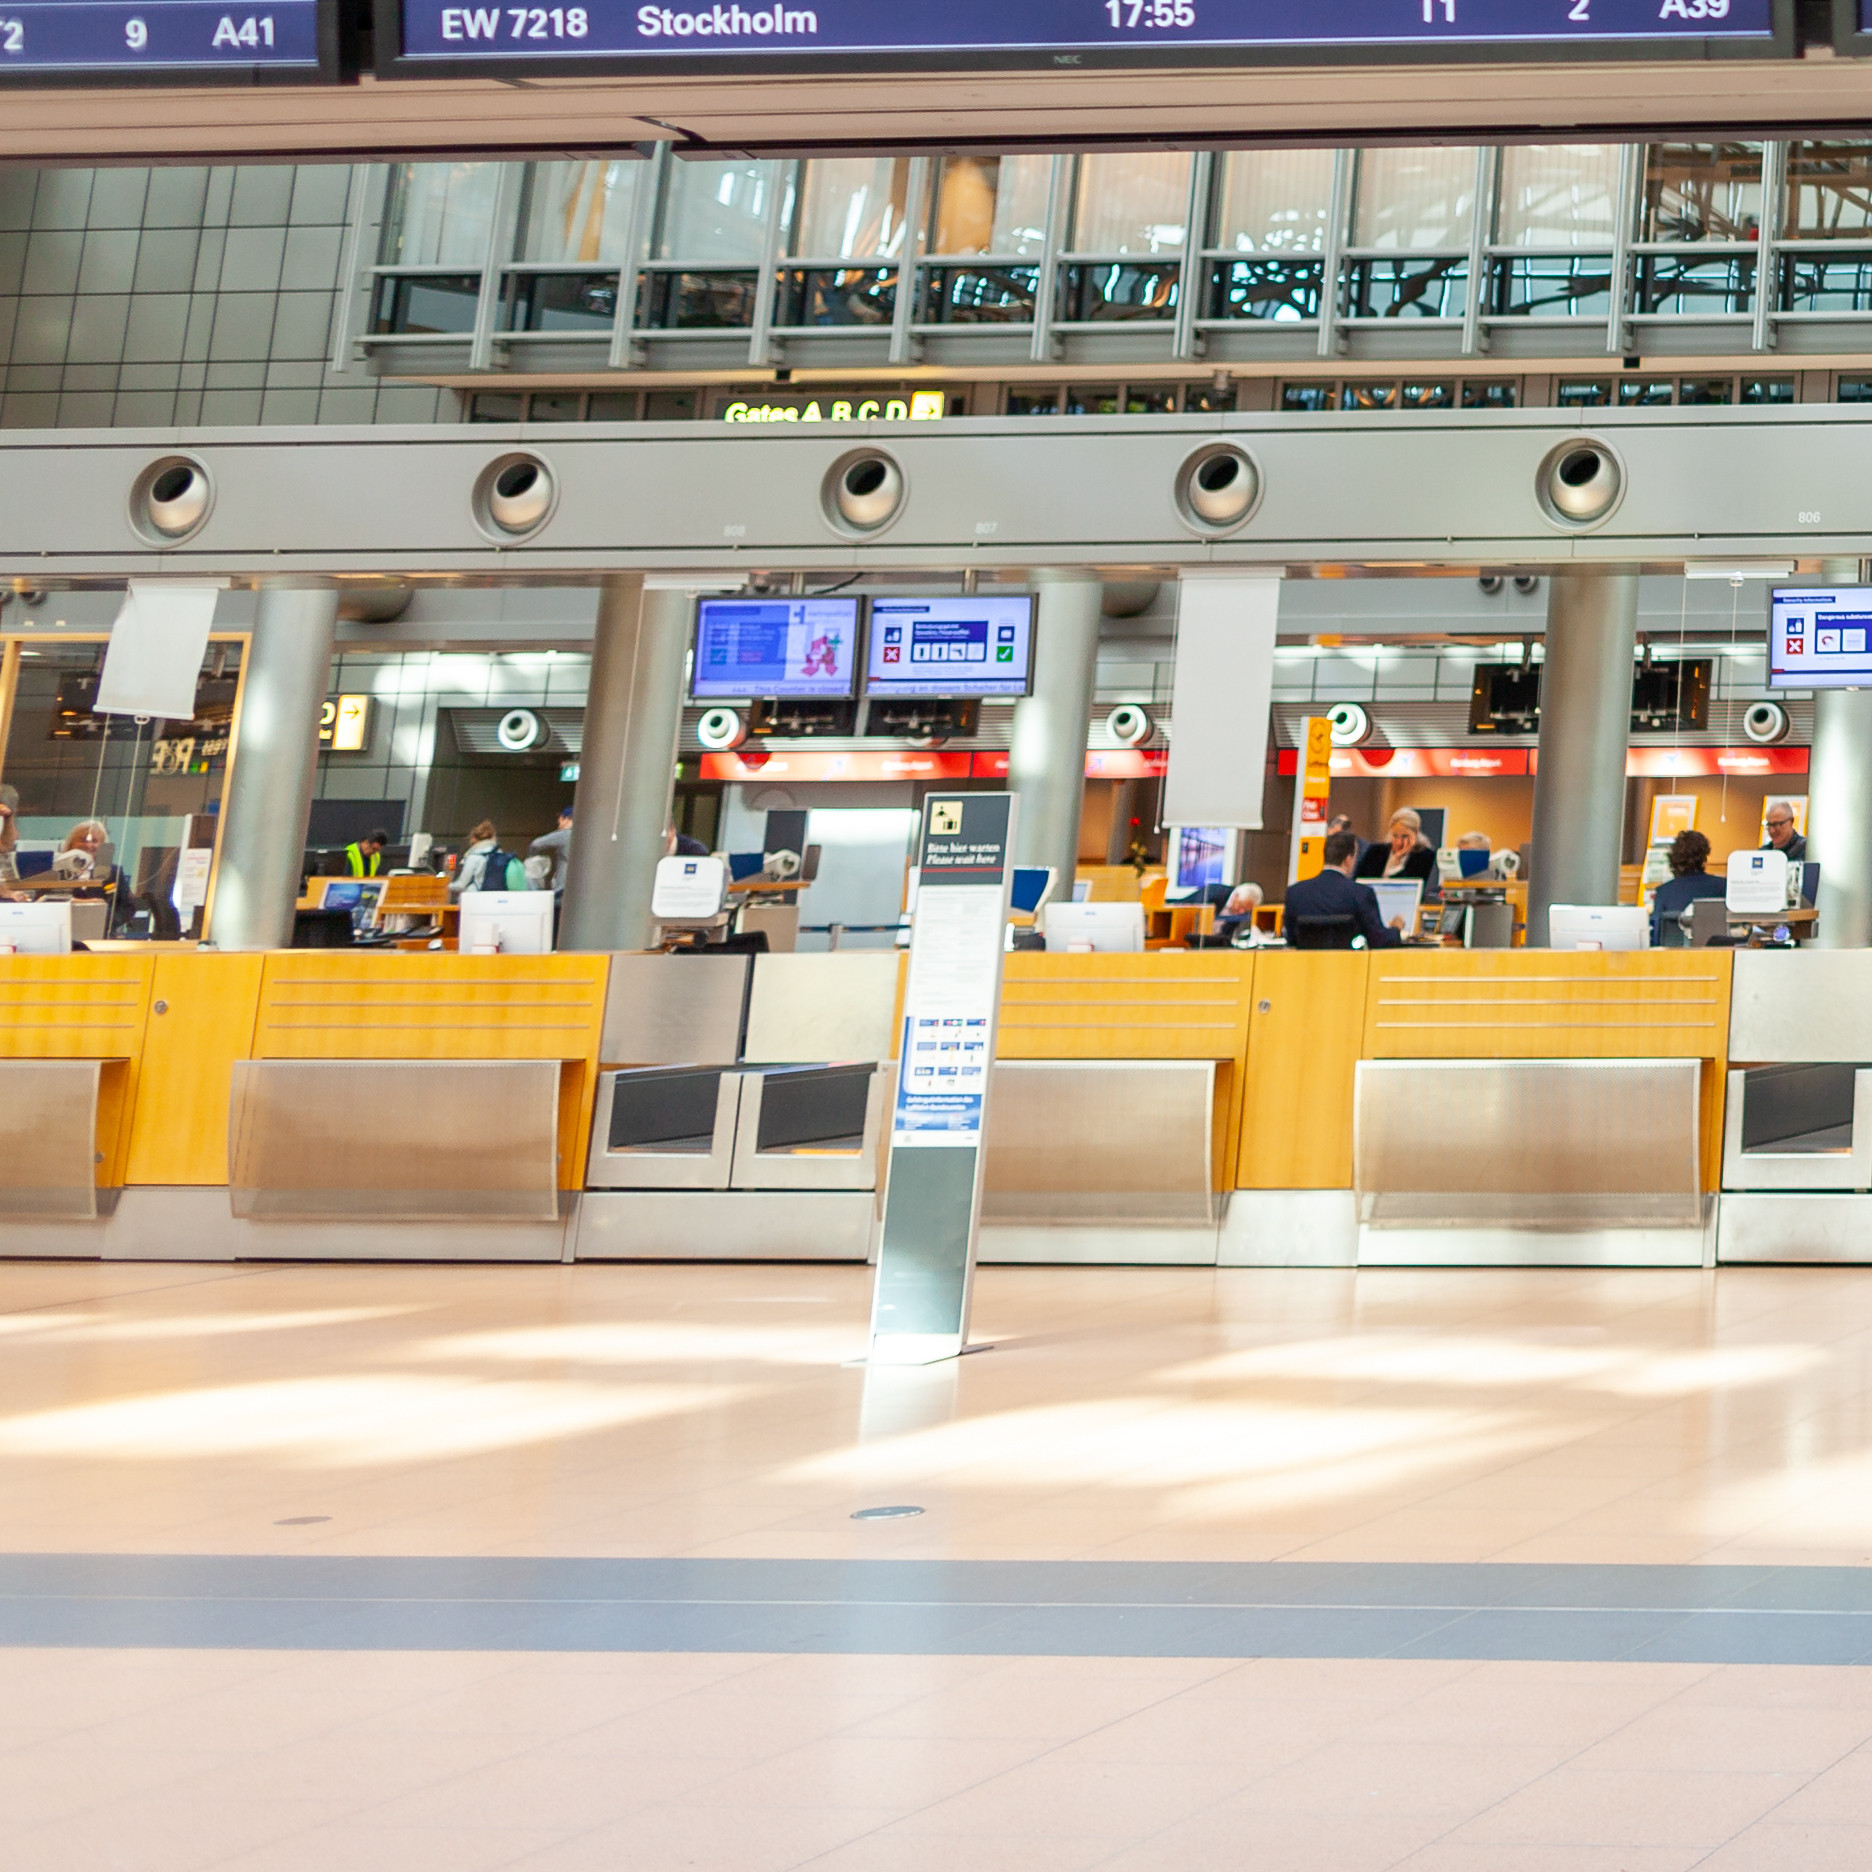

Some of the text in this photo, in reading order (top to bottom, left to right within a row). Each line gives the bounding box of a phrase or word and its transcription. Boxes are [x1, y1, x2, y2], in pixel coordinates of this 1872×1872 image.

[1798, 511, 1821, 524] 806
[928, 841, 1001, 853] Bitte hier warten
[926, 853, 997, 865] Please wait here
